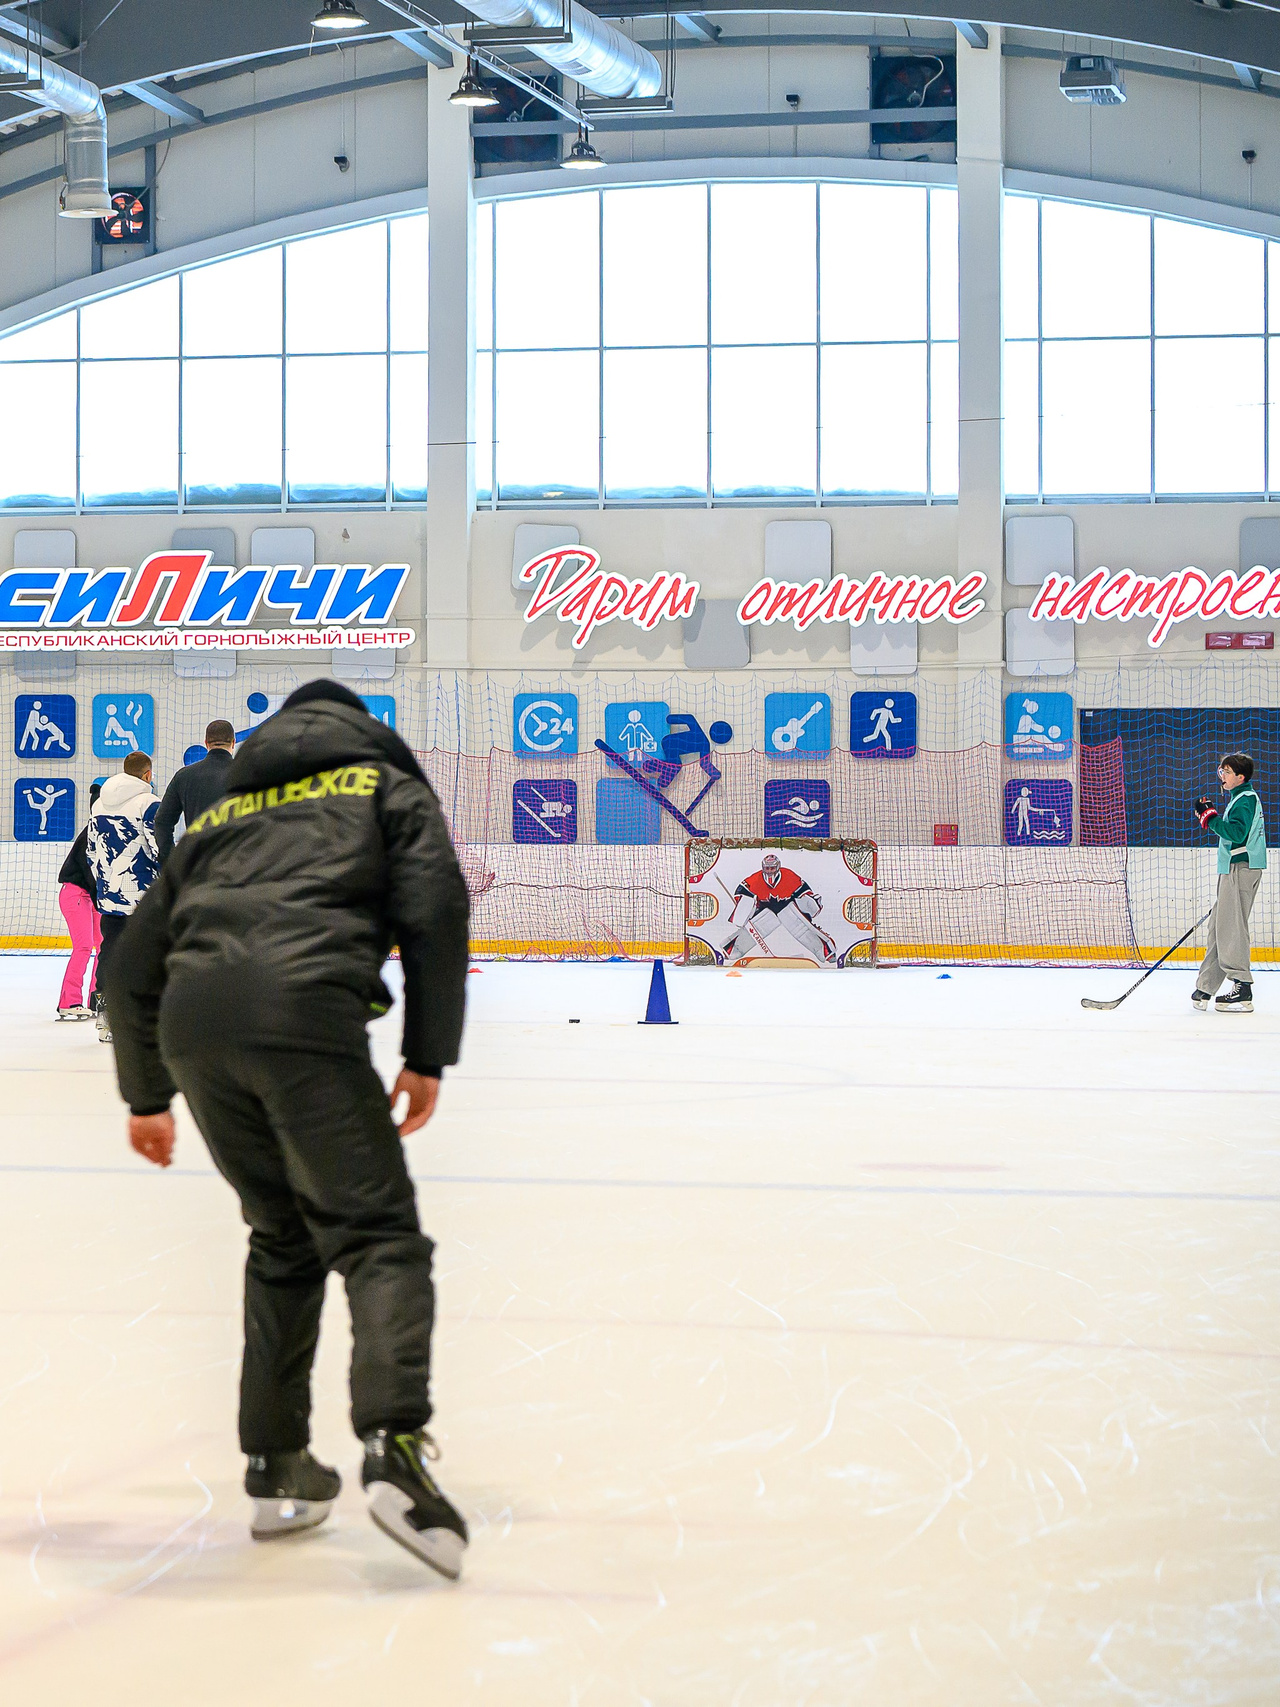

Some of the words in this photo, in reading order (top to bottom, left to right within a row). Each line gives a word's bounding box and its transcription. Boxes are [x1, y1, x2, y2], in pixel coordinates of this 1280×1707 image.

[524, 549, 695, 646] Дарим
[741, 575, 984, 627] отличное
[184, 630, 342, 646] ГОРНОЛЫЖНЫЙ
[347, 631, 411, 648] ЦЕНТР
[549, 717, 574, 735] 24
[752, 932, 769, 954] CANADA
